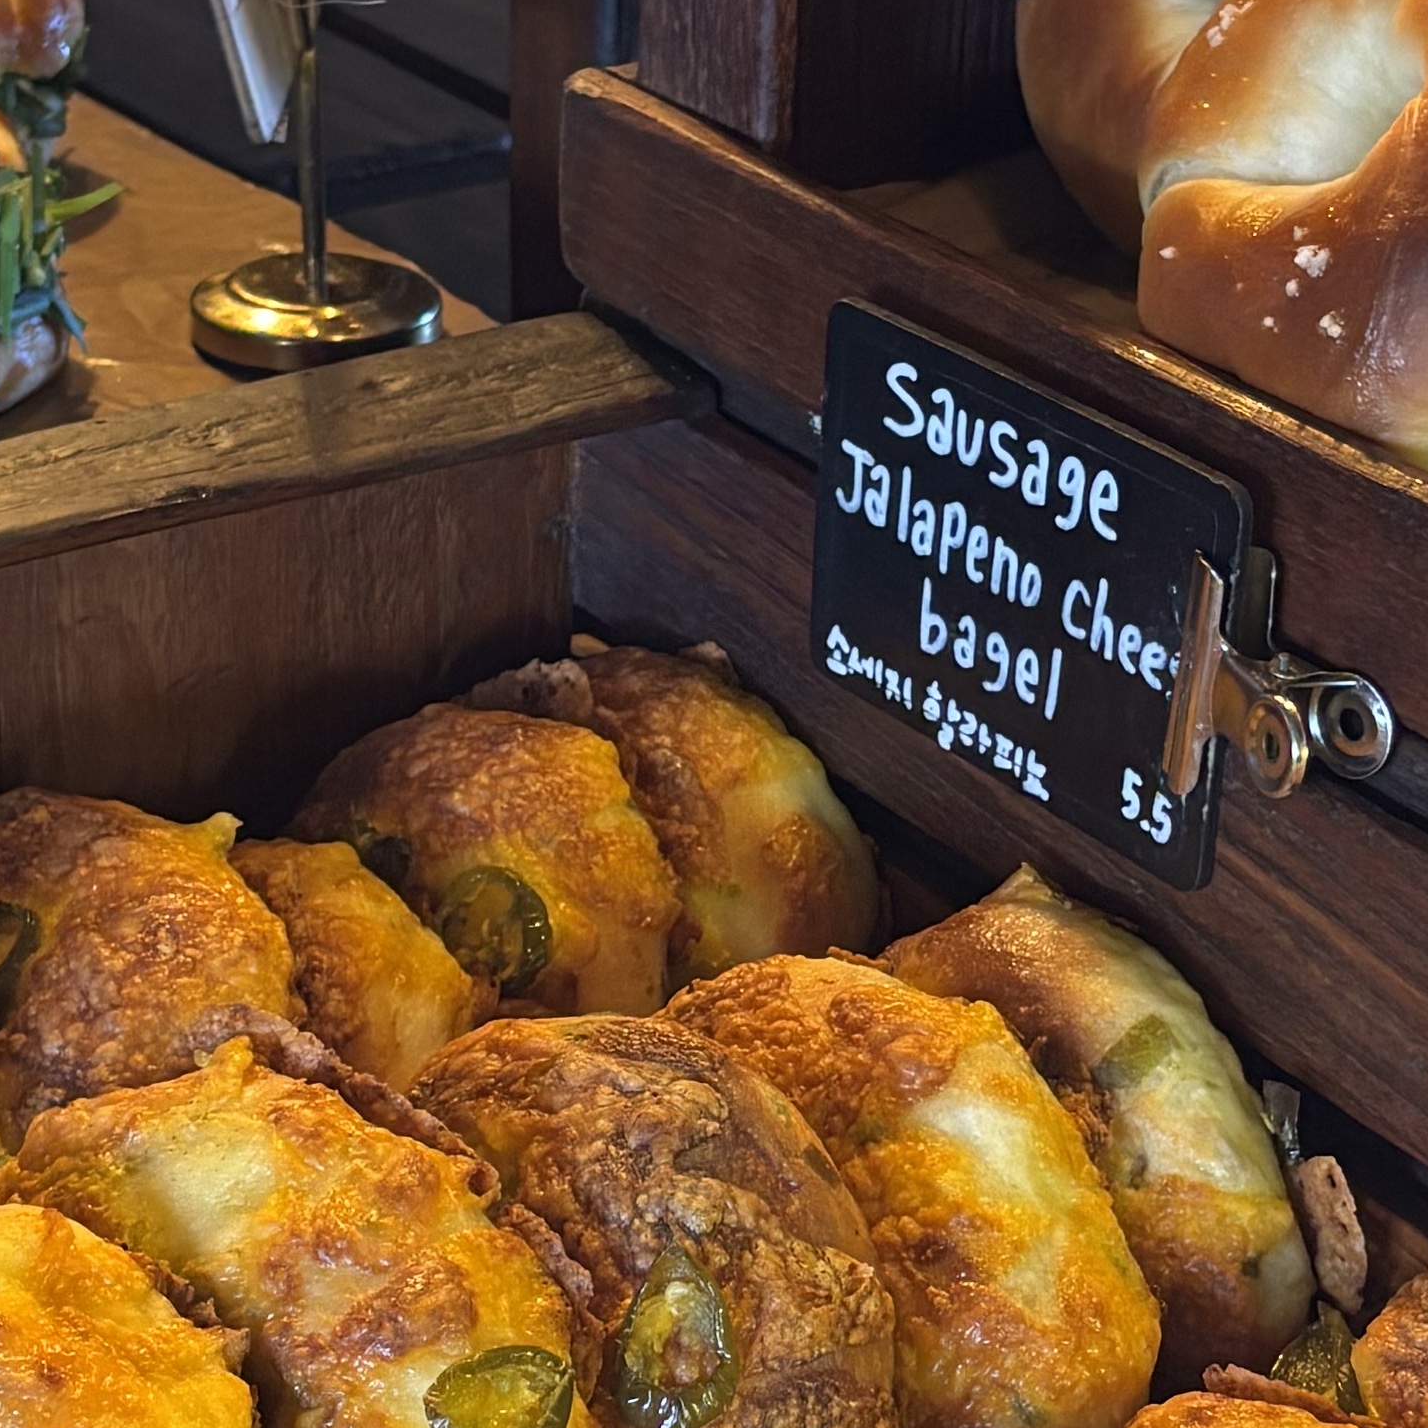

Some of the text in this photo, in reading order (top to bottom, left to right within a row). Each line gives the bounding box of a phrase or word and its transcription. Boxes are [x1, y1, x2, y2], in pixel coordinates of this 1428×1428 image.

[835, 439, 1042, 607] Jalapeno
[883, 363, 1120, 541] Sausage
[826, 624, 913, 710] 소세지
[919, 577, 1063, 720] bagel
[1120, 768, 1173, 844] 5.5
